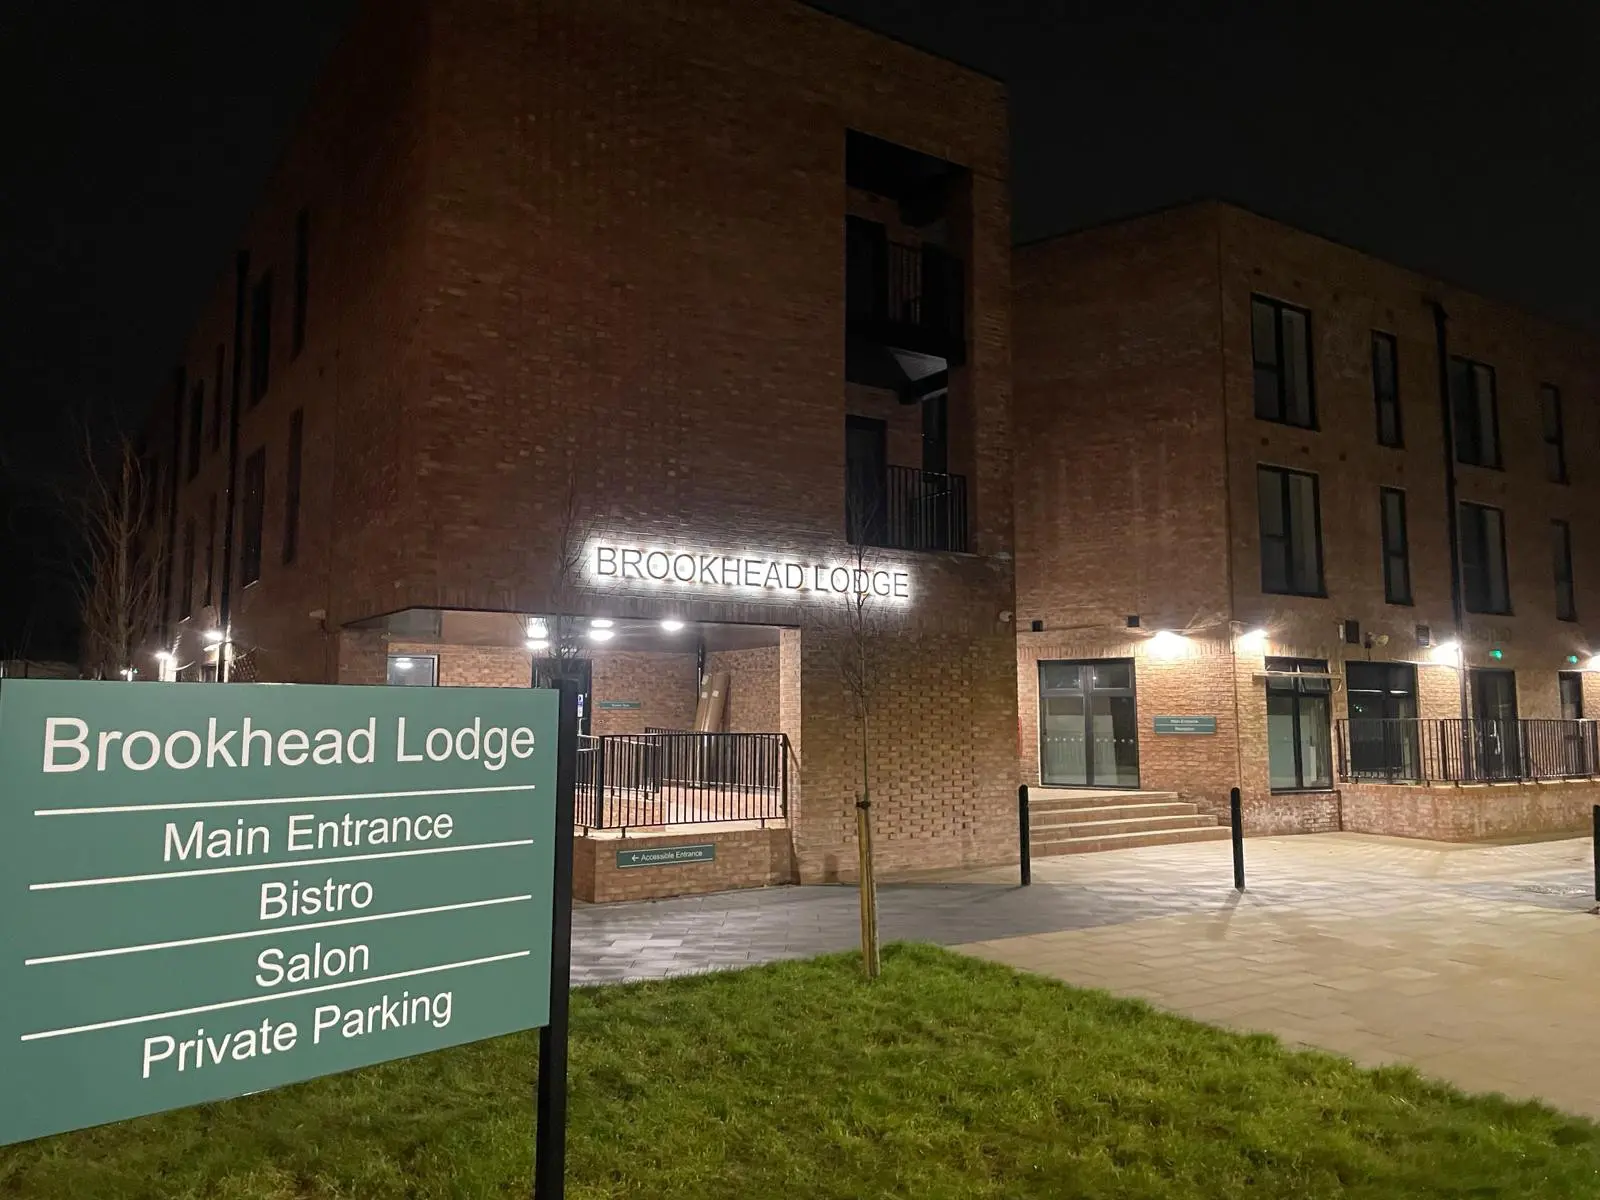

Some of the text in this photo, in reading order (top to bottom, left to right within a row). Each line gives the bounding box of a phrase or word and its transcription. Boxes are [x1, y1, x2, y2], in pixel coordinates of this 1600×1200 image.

[596, 546, 909, 598] BROOKHEAD LODGE
[42, 716, 536, 773] Brookhead Lodge
[163, 812, 454, 862] Main Entrance
[641, 850, 703, 862] Accessible Entrance
[259, 877, 374, 921] Bistro
[255, 942, 370, 988] Salon
[142, 990, 453, 1079] Private Parking
